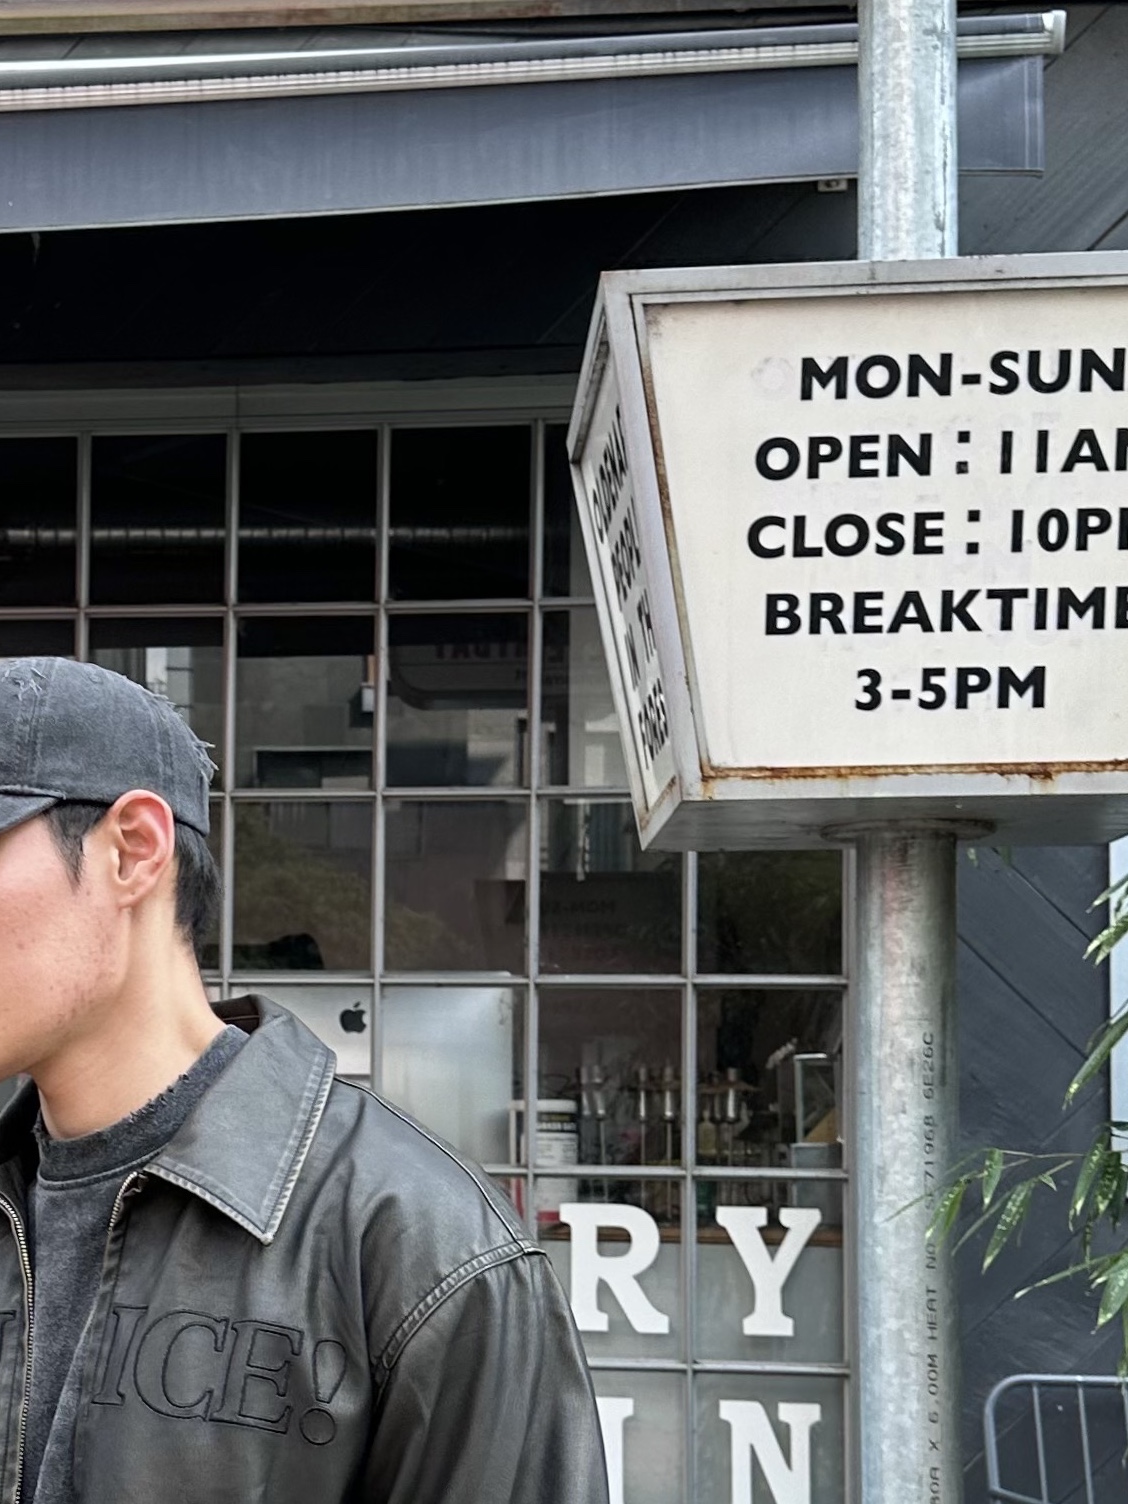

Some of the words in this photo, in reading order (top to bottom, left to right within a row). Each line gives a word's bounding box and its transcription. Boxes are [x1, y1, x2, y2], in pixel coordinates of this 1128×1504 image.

[799, 347, 1126, 402] MON-SUN
[611, 496, 641, 611] PEOPL
[1010, 506, 1128, 554] 10P
[854, 664, 1047, 712] 3-5PM
[925, 1285, 938, 1341] HEAT
